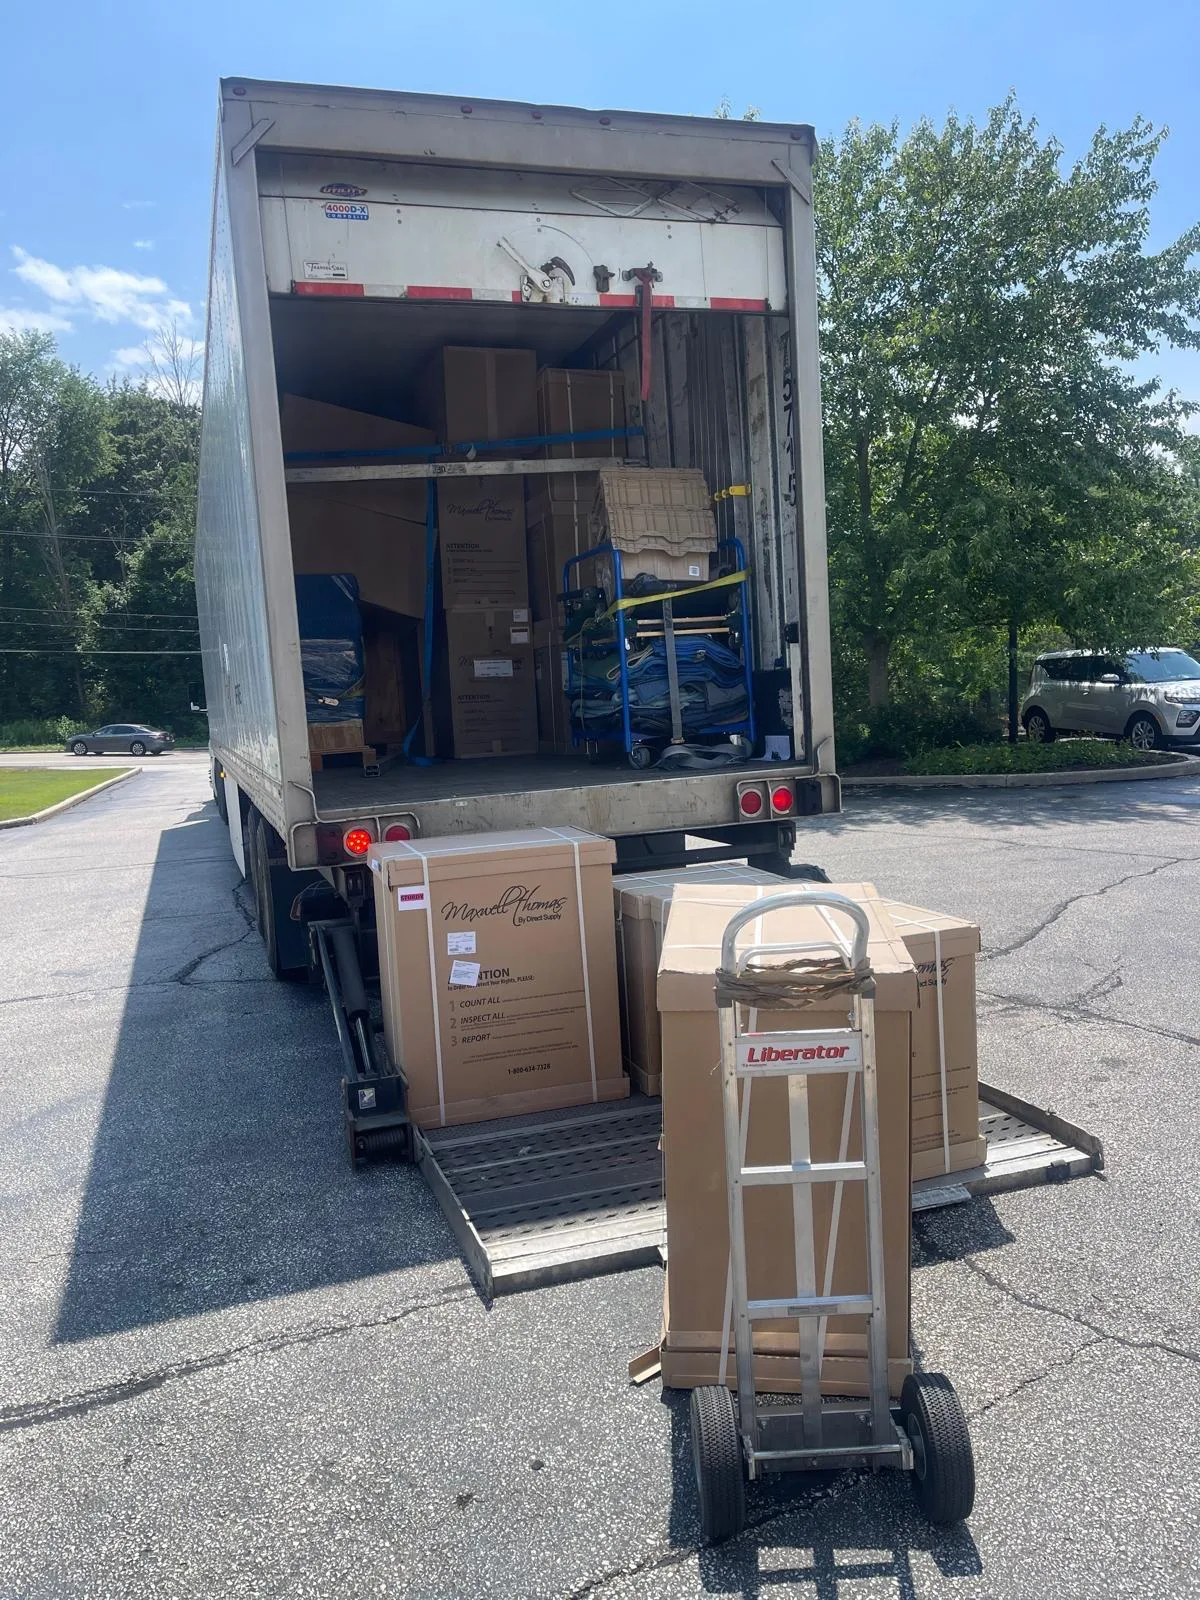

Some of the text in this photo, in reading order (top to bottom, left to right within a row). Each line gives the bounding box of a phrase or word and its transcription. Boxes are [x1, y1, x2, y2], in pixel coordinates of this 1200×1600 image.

[326, 204, 366, 214] 4000D-X
[440, 884, 568, 927] Maxwell Thomas
[526, 915, 543, 924] Direct
[543, 913, 562, 923] Supply
[449, 996, 501, 1012] 1 COUNT ALL
[450, 1018, 457, 1029] 2
[460, 1014, 493, 1025] INSPECT
[492, 1012, 506, 1021] ALL
[451, 1035, 458, 1047] 3
[461, 1033, 491, 1044] REPORT
[747, 1045, 850, 1063] Liberator
